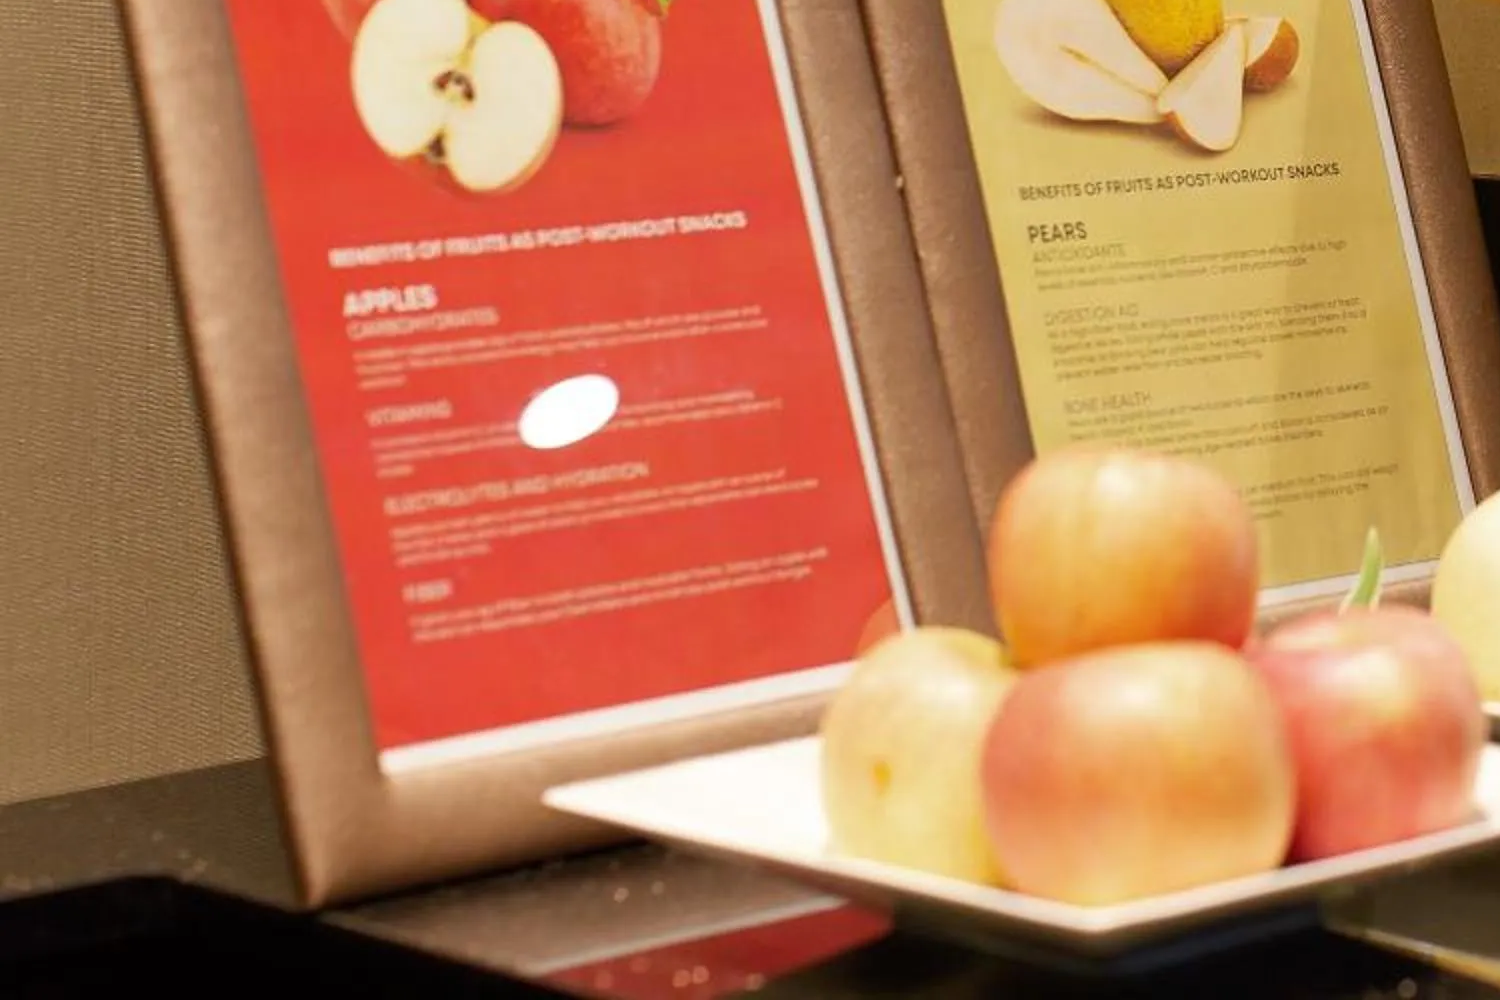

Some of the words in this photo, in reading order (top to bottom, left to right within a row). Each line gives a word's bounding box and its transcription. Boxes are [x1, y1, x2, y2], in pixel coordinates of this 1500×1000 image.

[1019, 183, 1082, 201] BENEFITS
[1083, 182, 1103, 197] OF
[1105, 177, 1153, 194] FRUITS
[1156, 175, 1174, 190] AS
[1175, 167, 1284, 188] POST-WORKOUT
[1287, 162, 1340, 179] SNACKS
[328, 241, 416, 269] BENEFITS
[416, 239, 443, 260] OF
[444, 232, 507, 256] FRUITS
[677, 210, 748, 234] SNACKS
[1027, 220, 1087, 244] PEARS
[343, 283, 439, 318] APPLES
[1101, 390, 1151, 409] HEALTH
